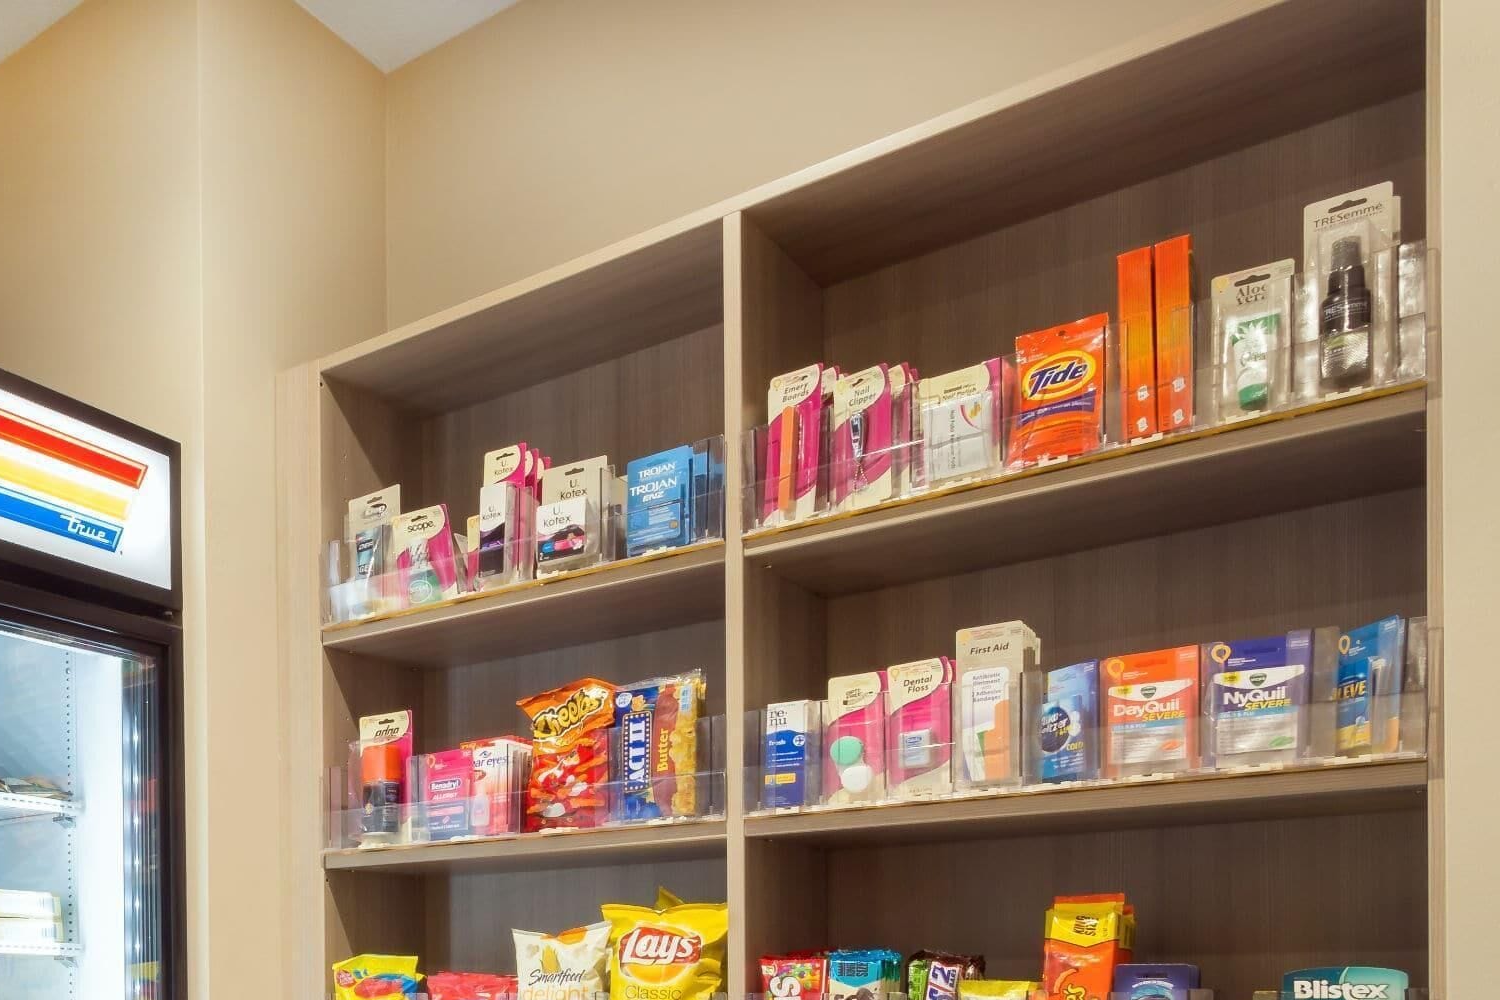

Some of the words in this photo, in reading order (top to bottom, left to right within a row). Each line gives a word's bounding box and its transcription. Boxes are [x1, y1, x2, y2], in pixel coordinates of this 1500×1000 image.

[1029, 361, 1088, 398] Tide
[782, 389, 809, 402] Boards
[784, 383, 809, 395] Emery
[854, 386, 870, 396] Nail
[849, 393, 877, 406] Clipper
[638, 462, 676, 477] TROJAN
[630, 477, 677, 497] TROJAN
[408, 521, 434, 532] scope
[970, 646, 991, 654] First
[994, 643, 1009, 651] Aid
[903, 675, 933, 687] Dental
[907, 684, 929, 694] Floss
[1223, 686, 1286, 707] NyQuil
[1113, 698, 1180, 718] DayQuil
[1244, 698, 1292, 711] SEVERE
[533, 686, 609, 737] Cheetos
[1142, 711, 1186, 721] SEVERE
[657, 728, 669, 772] Butter
[487, 756, 507, 768] eyes
[431, 780, 459, 790] Benadryl
[528, 967, 586, 986] Smartfood
[932, 966, 951, 985] 2
[625, 985, 682, 1000] Classic
